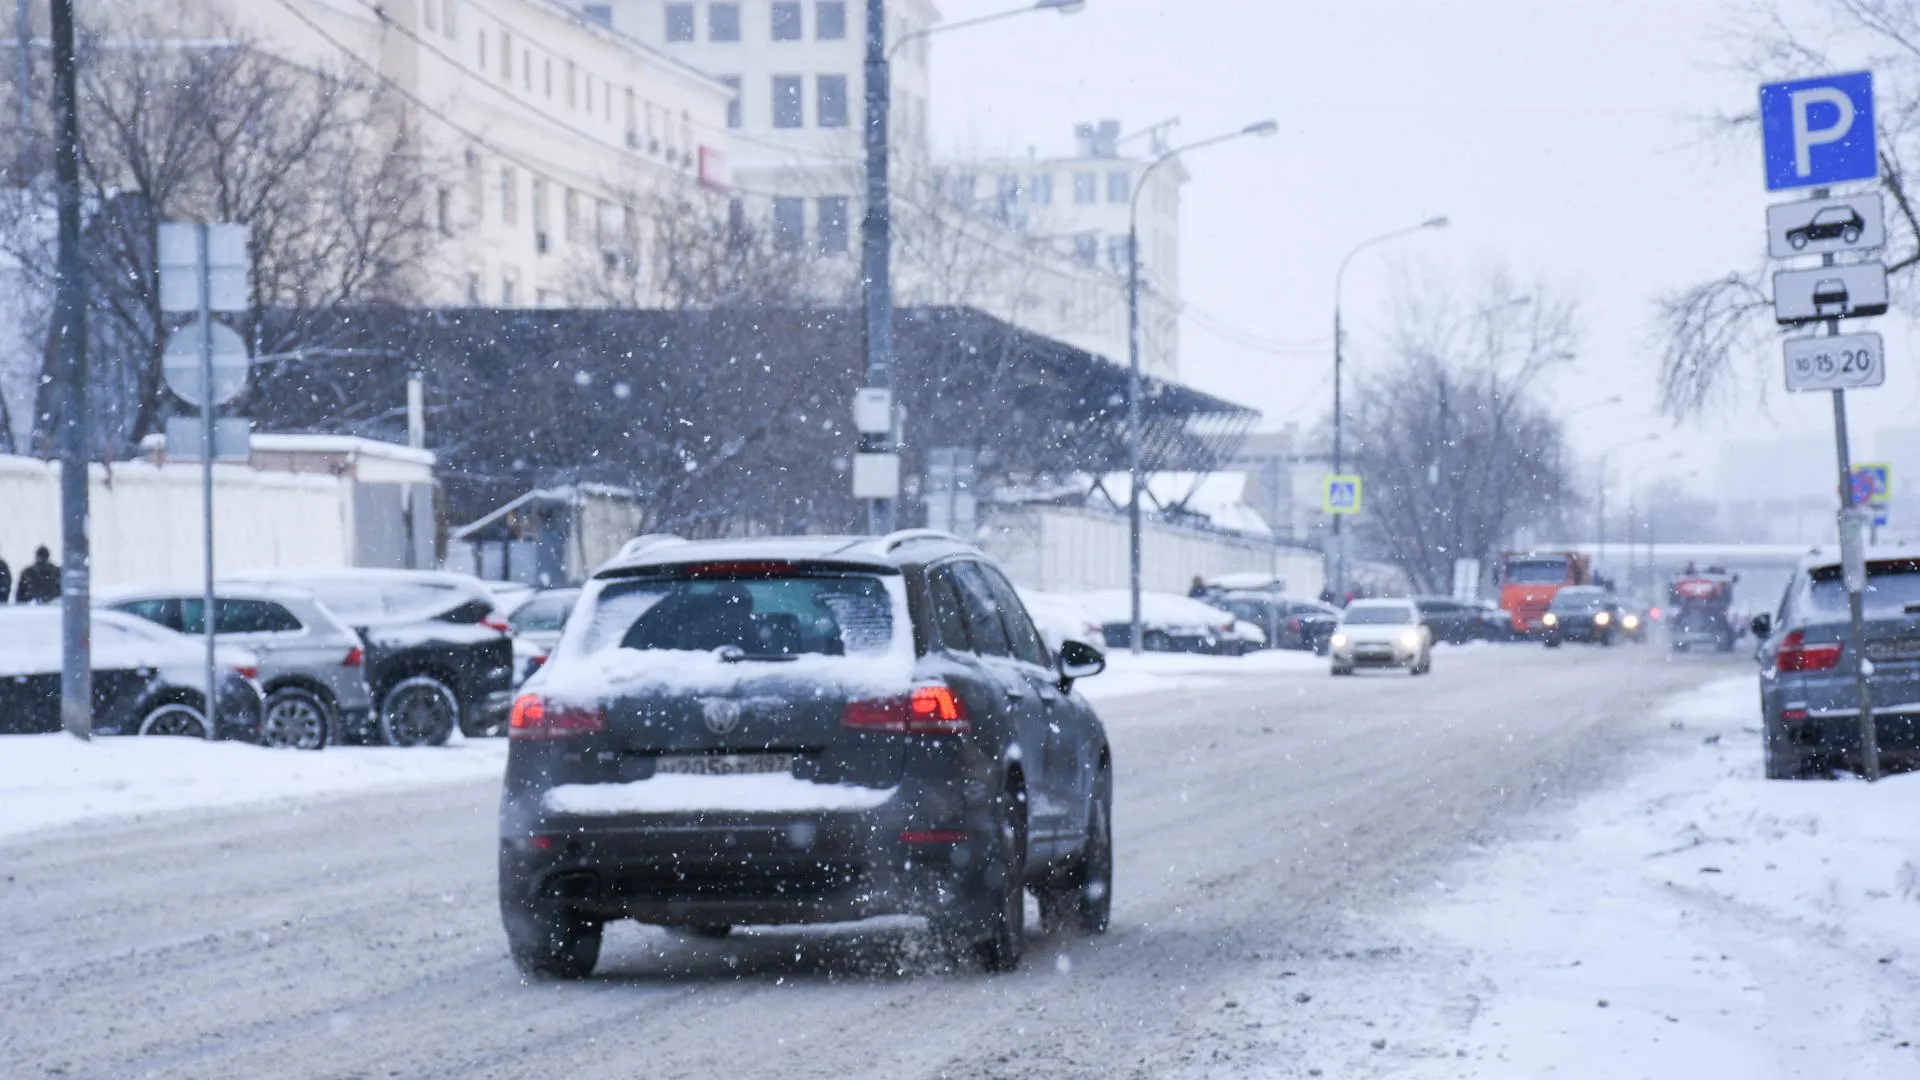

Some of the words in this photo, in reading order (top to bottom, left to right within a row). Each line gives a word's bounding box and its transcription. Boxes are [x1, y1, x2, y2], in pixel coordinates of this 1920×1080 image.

[1791, 86, 1854, 176] P
[1816, 353, 1833, 373] 15
[1841, 348, 1870, 373] 20
